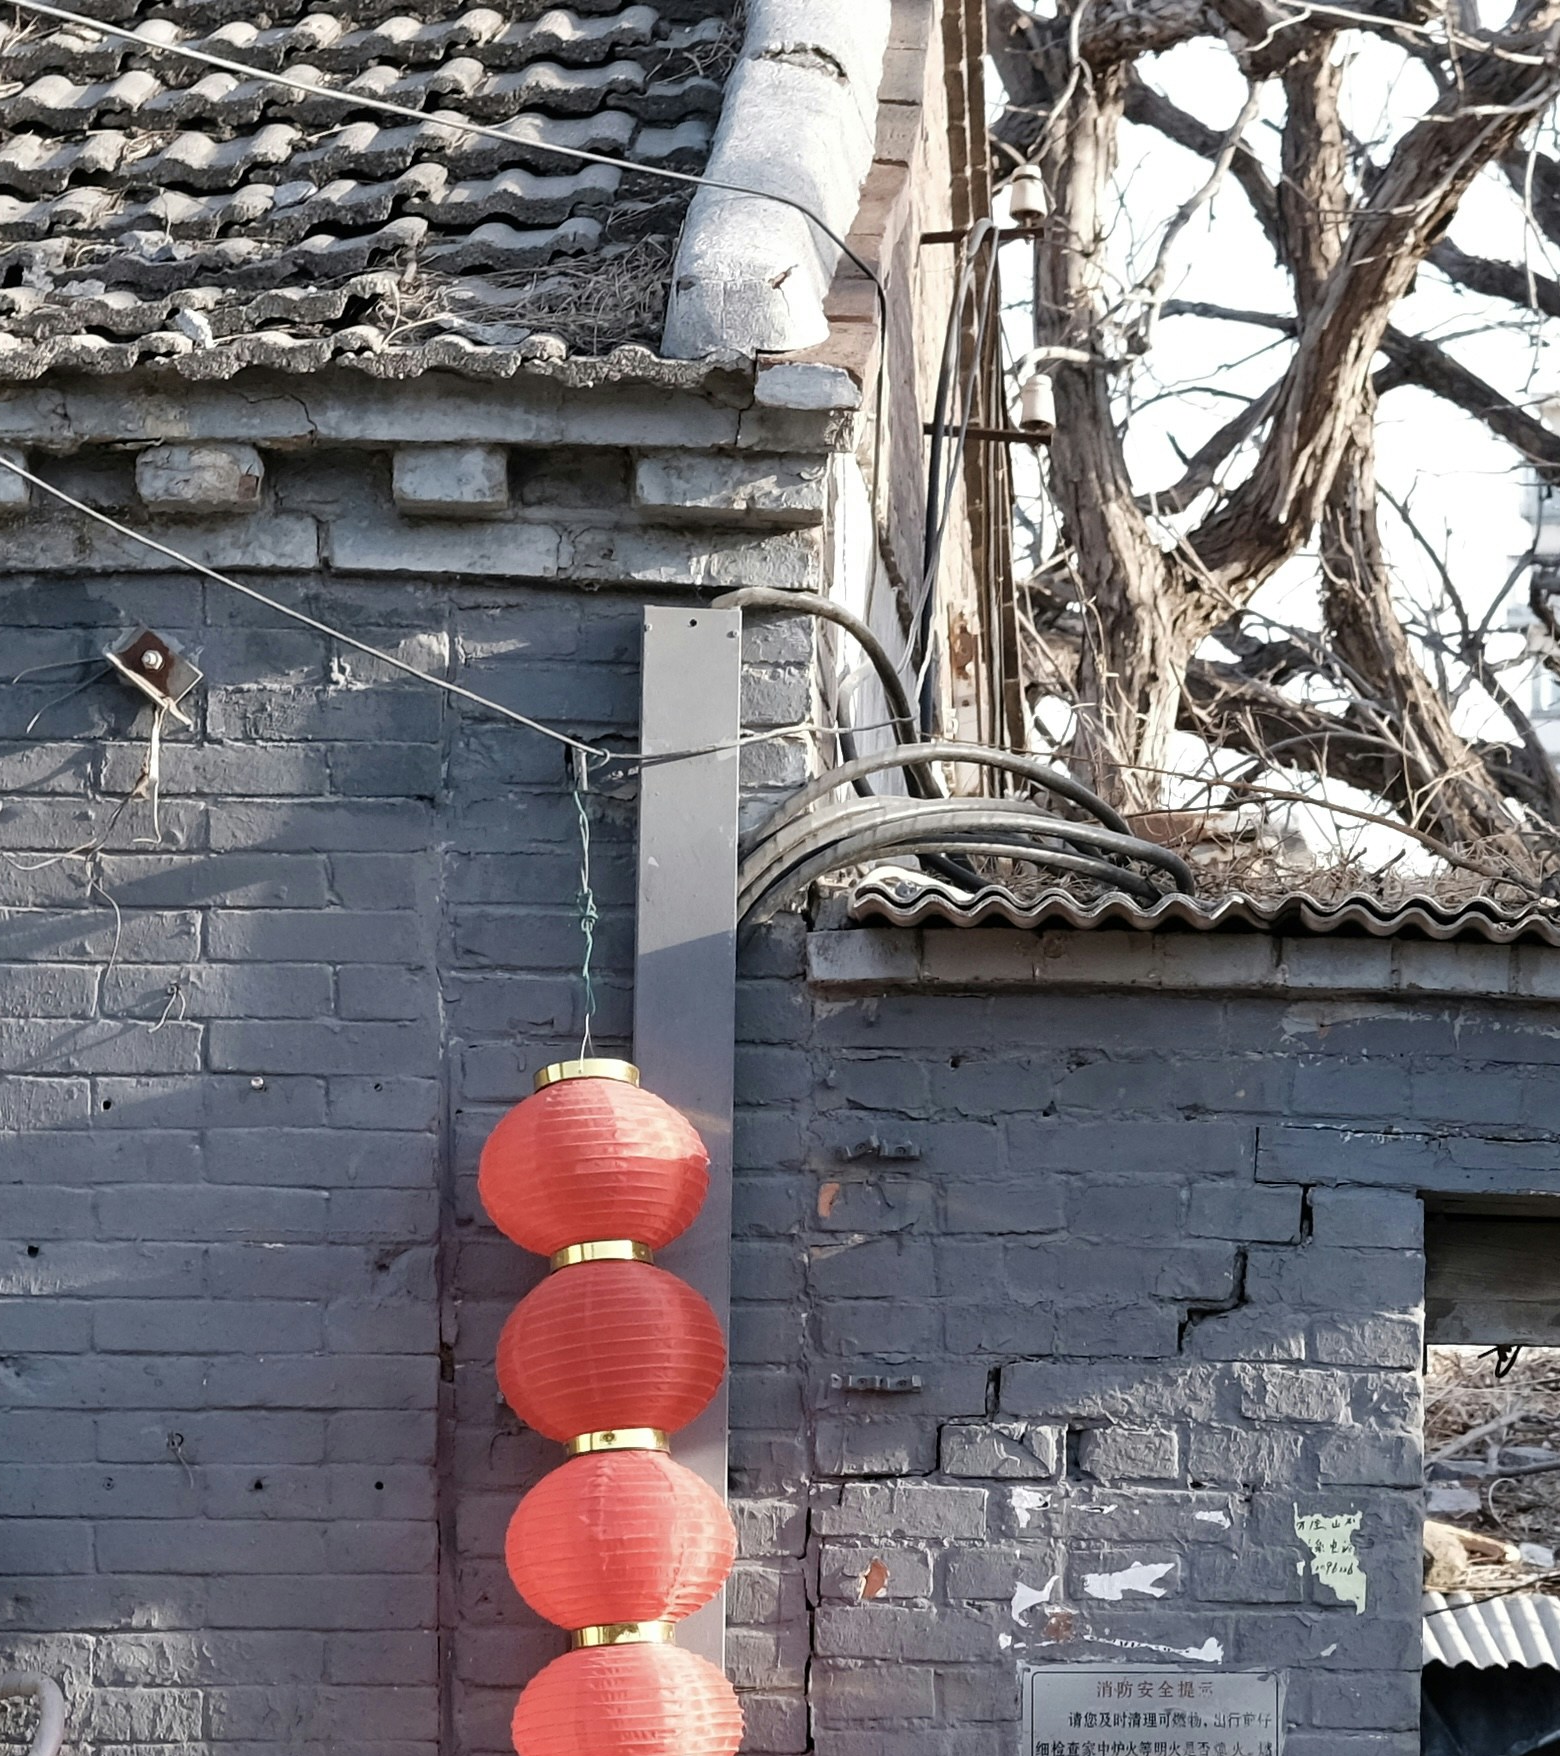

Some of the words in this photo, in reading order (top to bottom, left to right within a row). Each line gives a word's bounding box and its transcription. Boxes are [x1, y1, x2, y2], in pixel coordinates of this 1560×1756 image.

[1096, 1680, 1214, 1699] 消防安全提示
